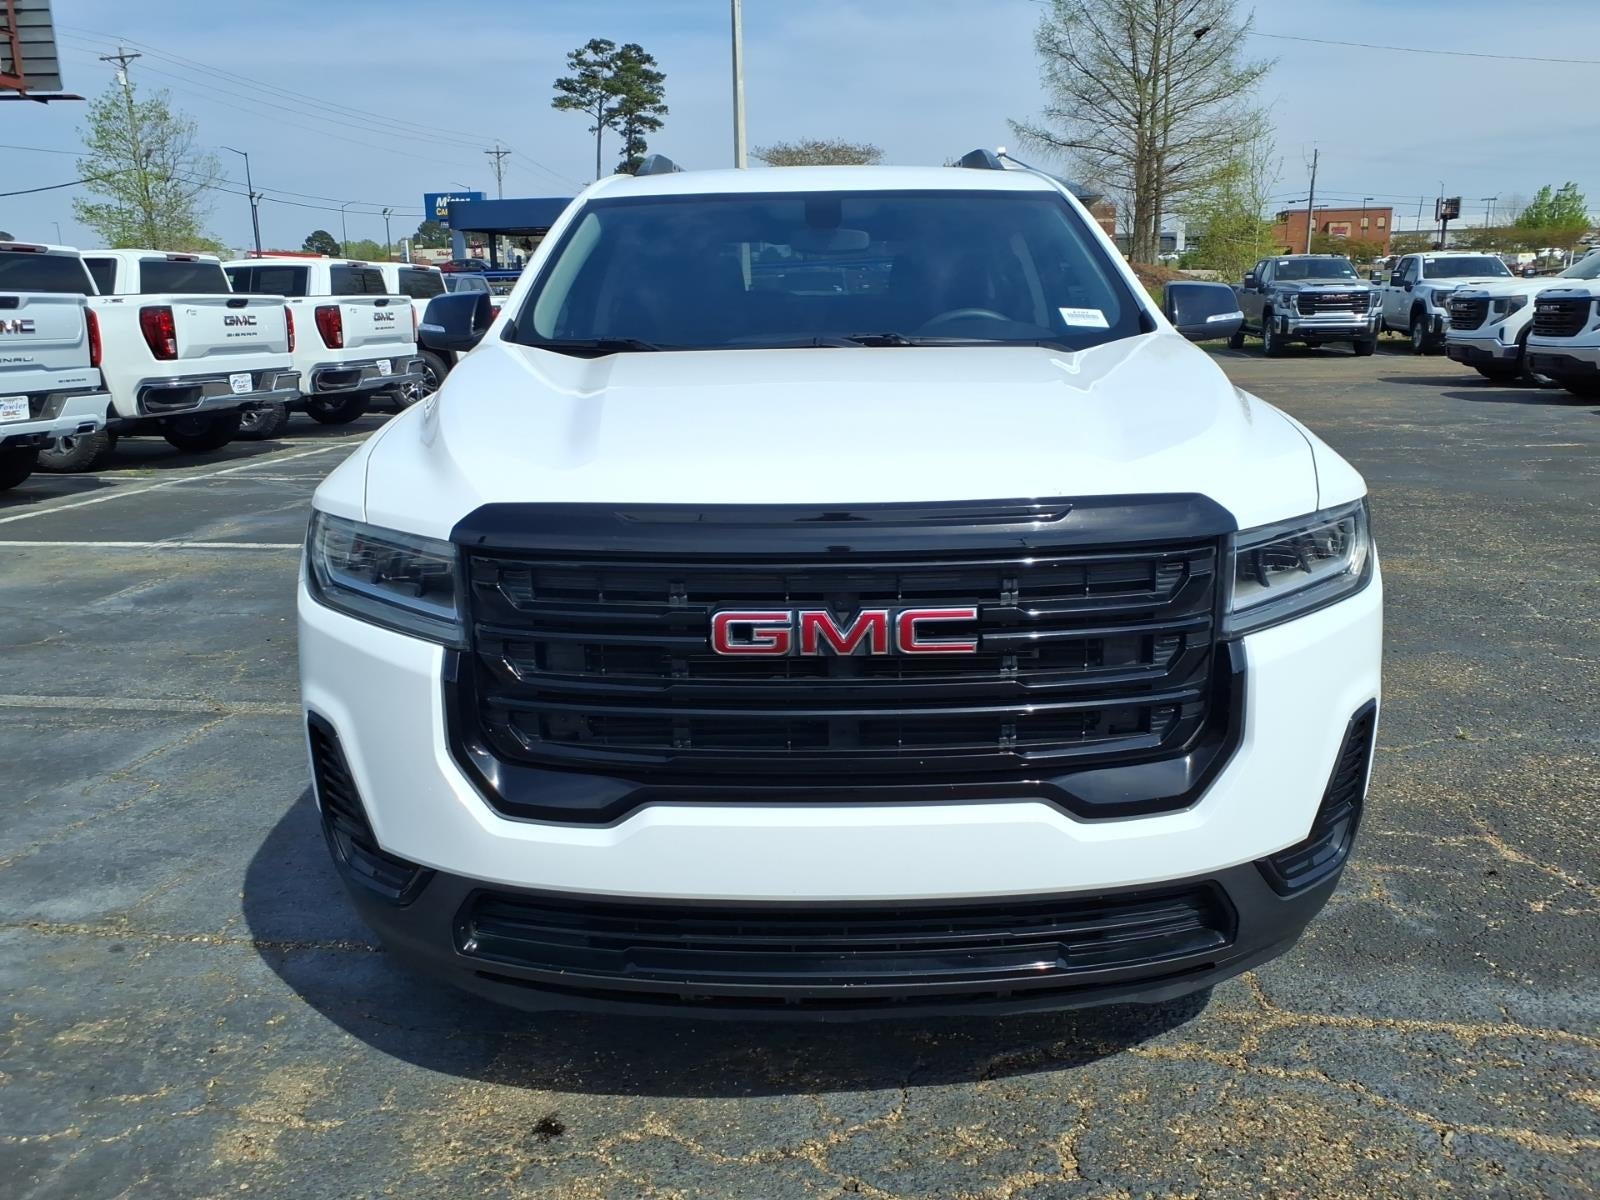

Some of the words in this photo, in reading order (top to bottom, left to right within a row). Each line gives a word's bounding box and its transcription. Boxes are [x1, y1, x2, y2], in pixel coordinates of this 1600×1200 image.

[224, 315, 257, 326] GMC
[373, 312, 395, 321] GMC
[0, 320, 36, 335] MC
[0, 402, 27, 411] owler
[711, 608, 979, 656] GMC
